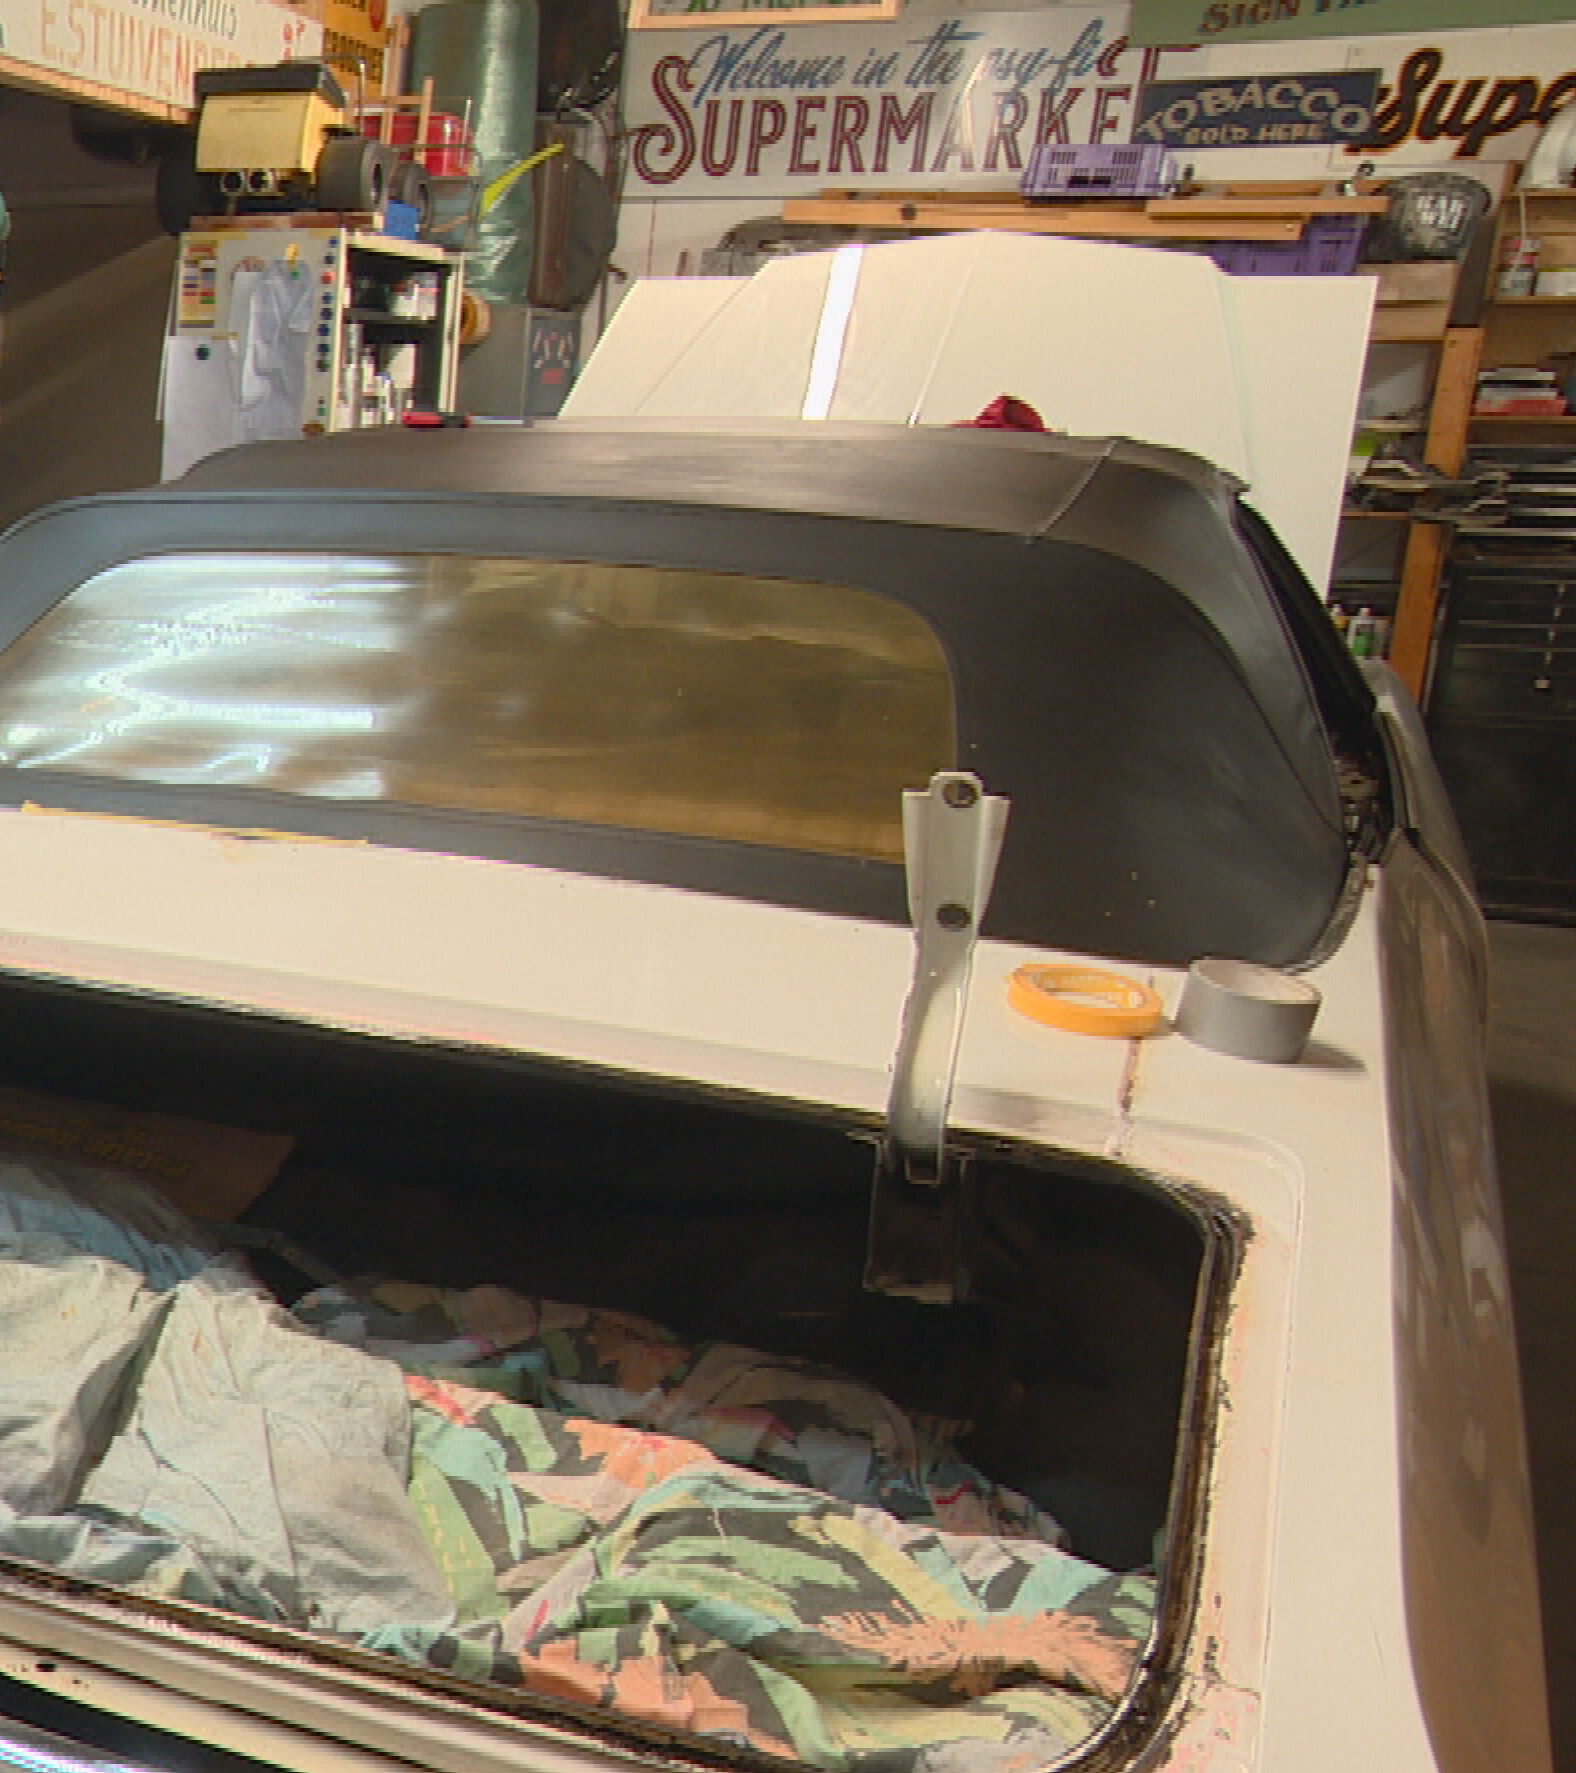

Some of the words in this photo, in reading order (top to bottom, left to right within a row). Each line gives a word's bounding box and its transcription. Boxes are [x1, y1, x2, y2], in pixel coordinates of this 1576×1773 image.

[685, 26, 845, 108] Welcome
[851, 47, 901, 88] in
[903, 18, 986, 88] the
[1137, 80, 1373, 143] TOBACCO
